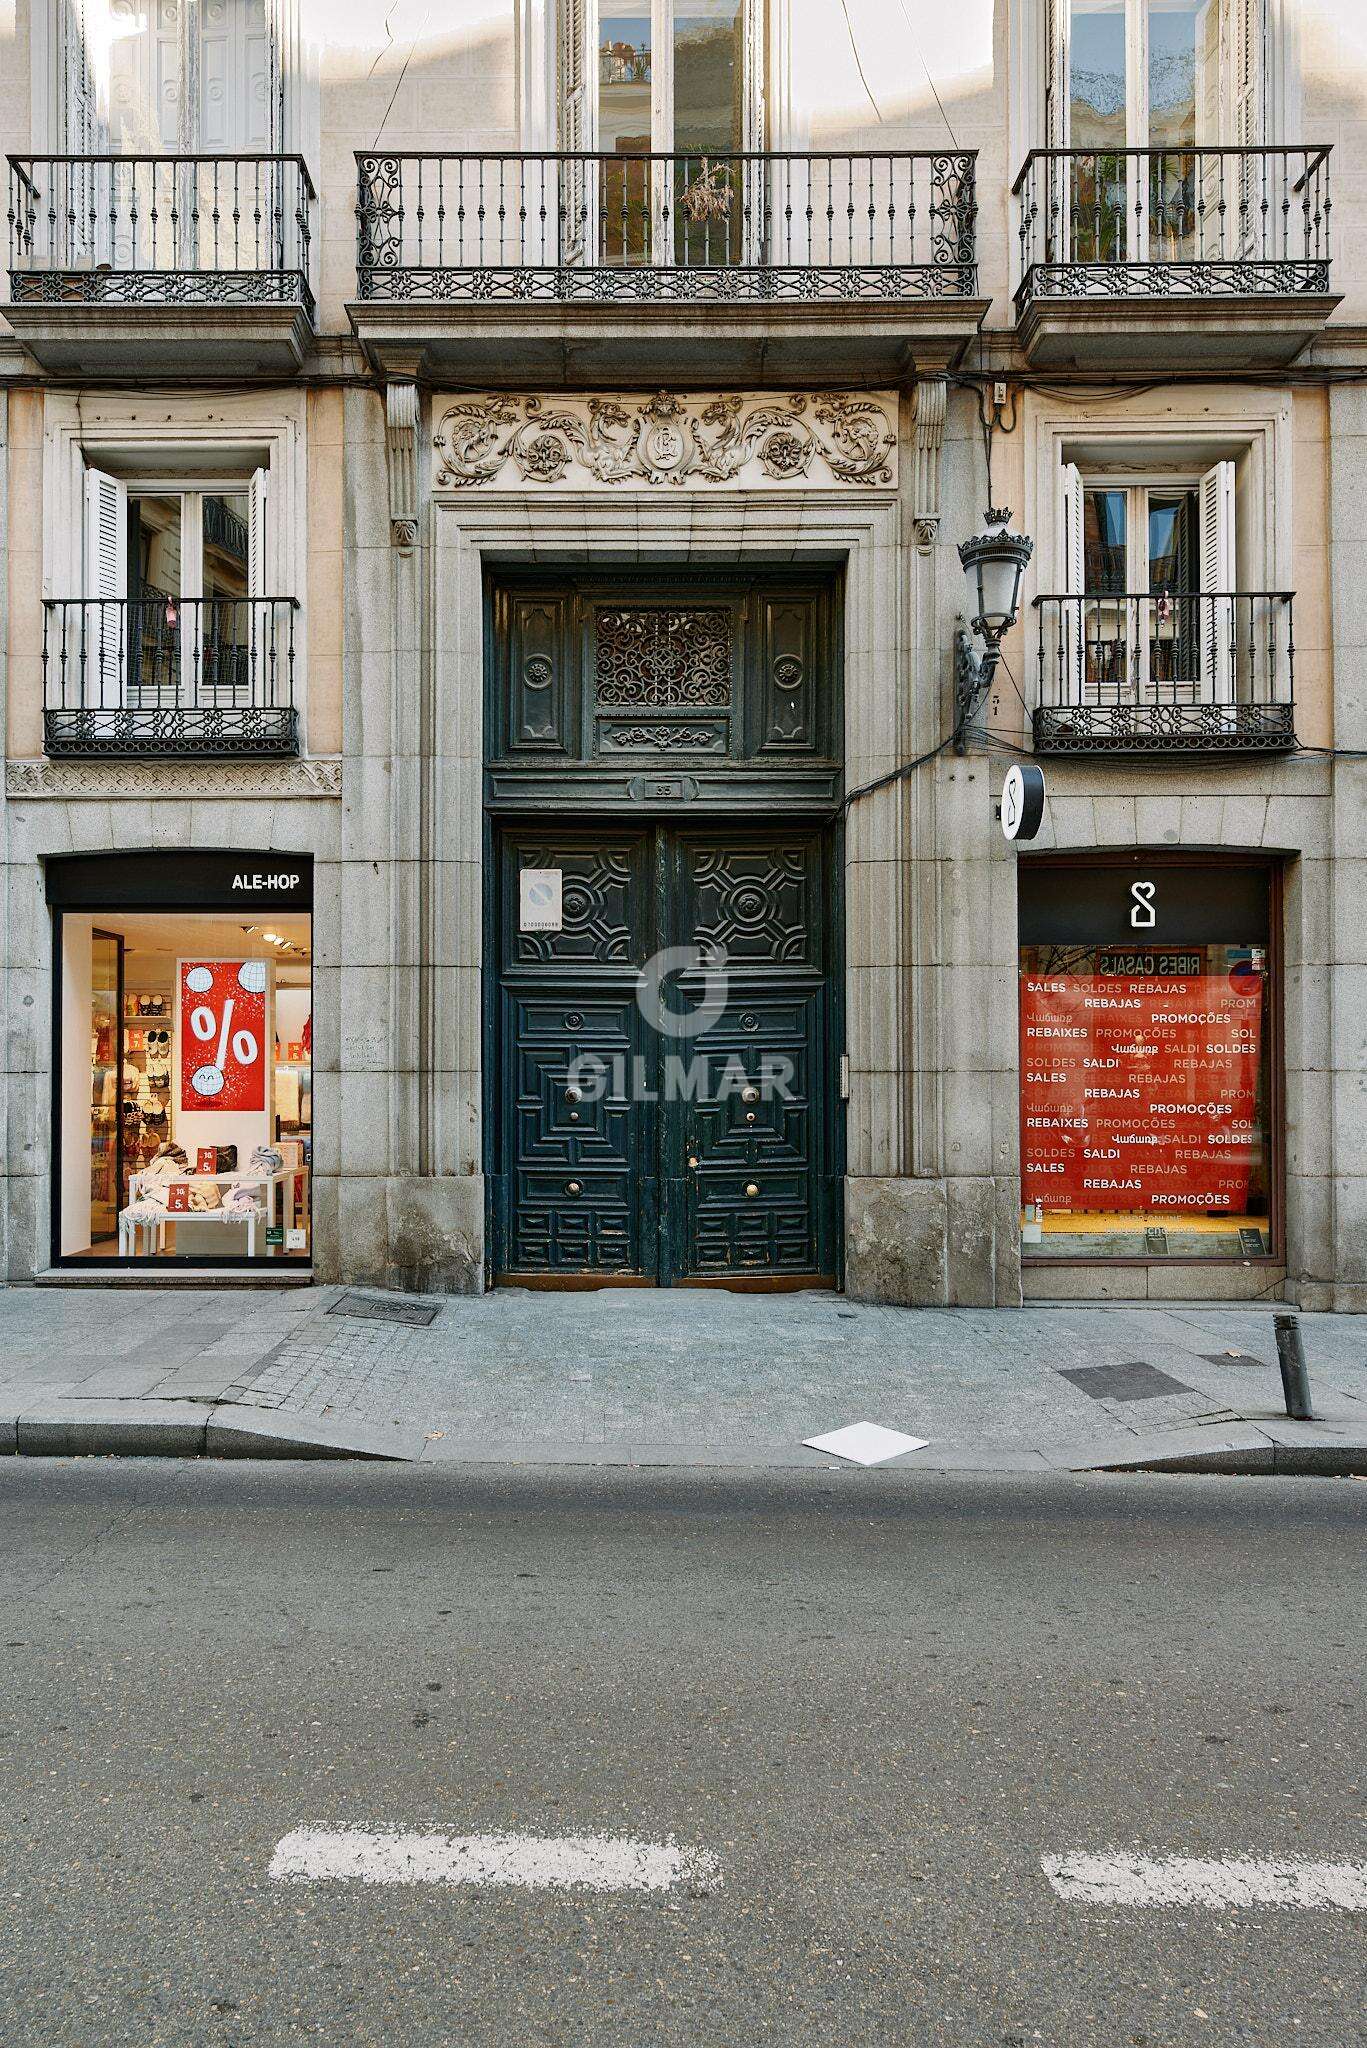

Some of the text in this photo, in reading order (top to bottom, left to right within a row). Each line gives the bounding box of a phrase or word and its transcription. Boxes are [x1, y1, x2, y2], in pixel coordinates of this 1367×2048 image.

[232, 874, 300, 889] ALE-HOP
[1027, 982, 1066, 993] SALES
[1073, 983, 1122, 993] SOLDES
[1129, 983, 1187, 994] REBAJAS
[1084, 998, 1141, 1009] REBAJAS
[1220, 998, 1257, 1009] PROM
[1151, 1011, 1231, 1026] PROMOÇÕES
[1027, 1027, 1088, 1038] REBAIXES
[1096, 1026, 1177, 1040] PROMOÇÕES
[1231, 1028, 1257, 1039] SOL
[1164, 1043, 1257, 1054] SALDI SOLDES
[1026, 1057, 1076, 1068] SOLDES
[1083, 1058, 1120, 1069] SALDI
[1174, 1058, 1233, 1069] REBAJAS
[1026, 1072, 1067, 1083] SALES
[1128, 1073, 1186, 1084] REBAJAS
[1084, 1088, 1140, 1099] REBAJAS
[1149, 1101, 1232, 1116] PROMOÇÕES
[1026, 1117, 1089, 1128] REBAIXES
[1096, 1117, 1176, 1130] PROMOÇÕES
[1164, 1134, 1253, 1145] SALDI SOLDES
[1026, 1147, 1076, 1158] SOLDES
[1083, 1148, 1121, 1159] SALDI
[1175, 1149, 1232, 1160] REBAJAS
[1026, 1162, 1065, 1173] SALES
[1130, 1164, 1188, 1175] REBAJAS
[1083, 1178, 1142, 1189] REBAJAS
[1151, 1192, 1231, 1206] PROMOÇÕES
